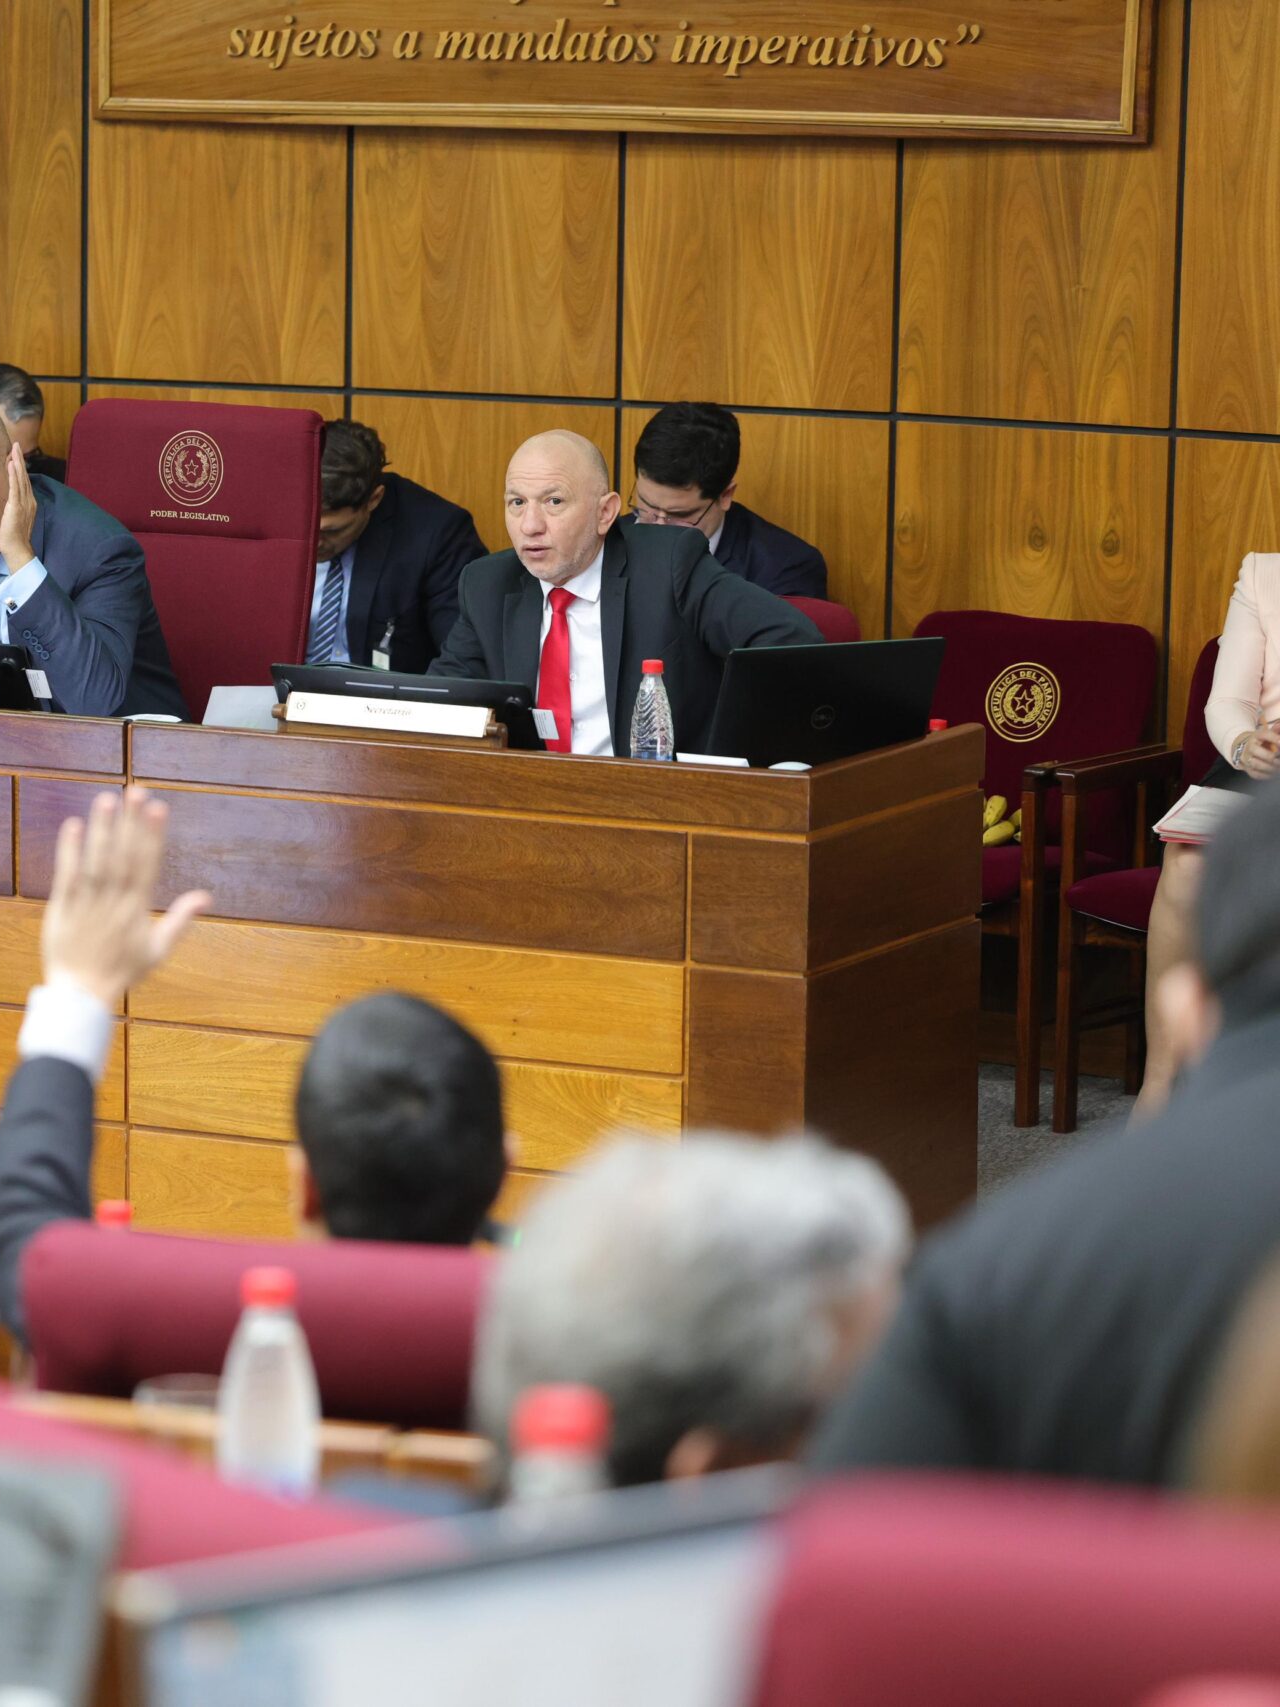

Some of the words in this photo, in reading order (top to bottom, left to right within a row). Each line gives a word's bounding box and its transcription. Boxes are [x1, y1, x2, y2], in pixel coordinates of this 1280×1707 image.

[226, 15, 380, 70] sujetos
[392, 28, 420, 60] a
[434, 17, 659, 63] mandatos
[165, 441, 184, 485] REPUBLICA
[201, 442, 218, 488] PARAGUAY
[150, 510, 178, 518] PODER
[180, 512, 230, 523] LEGISLATIVO
[993, 673, 1017, 725] REPUBLICA
[1019, 670, 1037, 679] DEL
[1038, 676, 1053, 728] PARAGUAY
